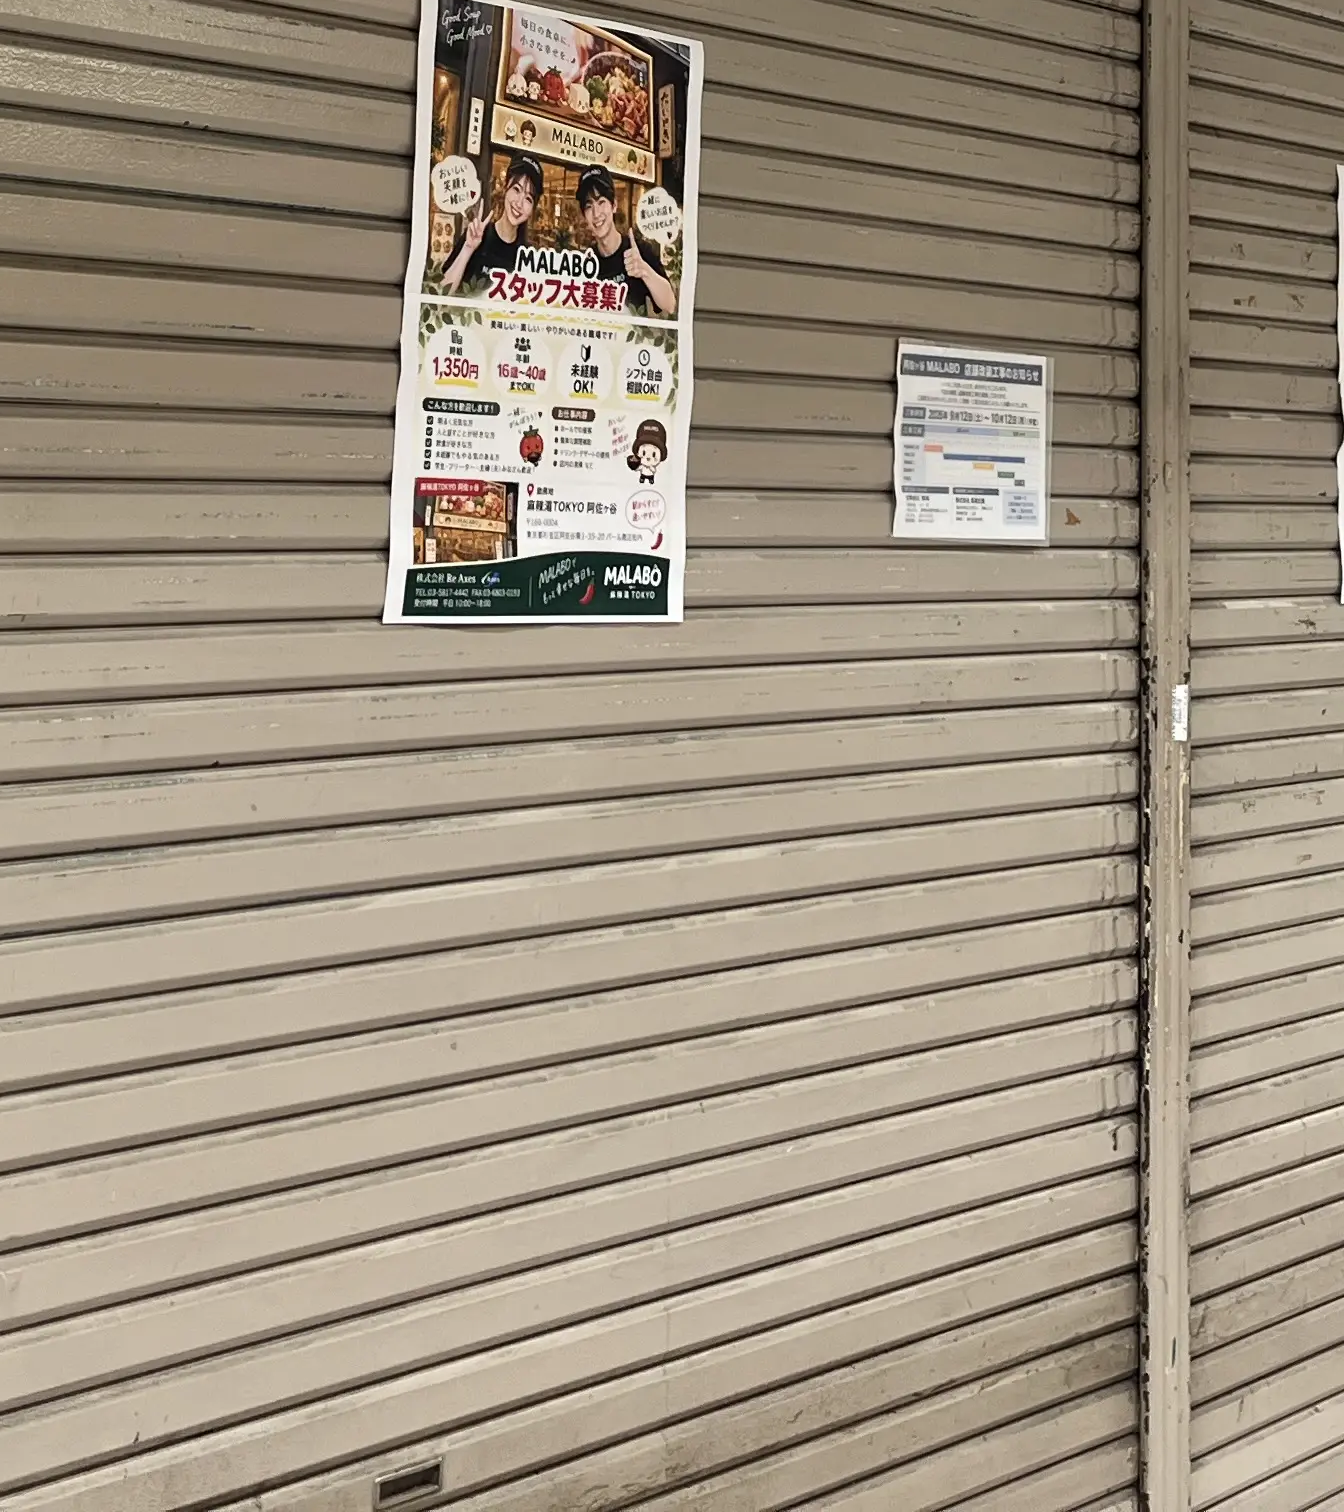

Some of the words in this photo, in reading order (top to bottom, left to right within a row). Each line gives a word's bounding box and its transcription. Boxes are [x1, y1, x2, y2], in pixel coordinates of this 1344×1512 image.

[441, 8, 461, 29] Good
[446, 28, 465, 47] Good
[551, 127, 604, 155] MALABO
[439, 163, 468, 180] おいしい
[517, 249, 598, 279] MALABO
[488, 271, 626, 312] スタッフ大募集!
[432, 356, 479, 380] 1,350円
[570, 364, 599, 379] 未経験
[626, 368, 663, 382] シフト自由
[926, 360, 961, 374] MALABO
[573, 380, 594, 394] OK!
[626, 381, 660, 395] 相談OK!
[603, 564, 662, 587] MALABO
[631, 590, 656, 600] TOKYO
